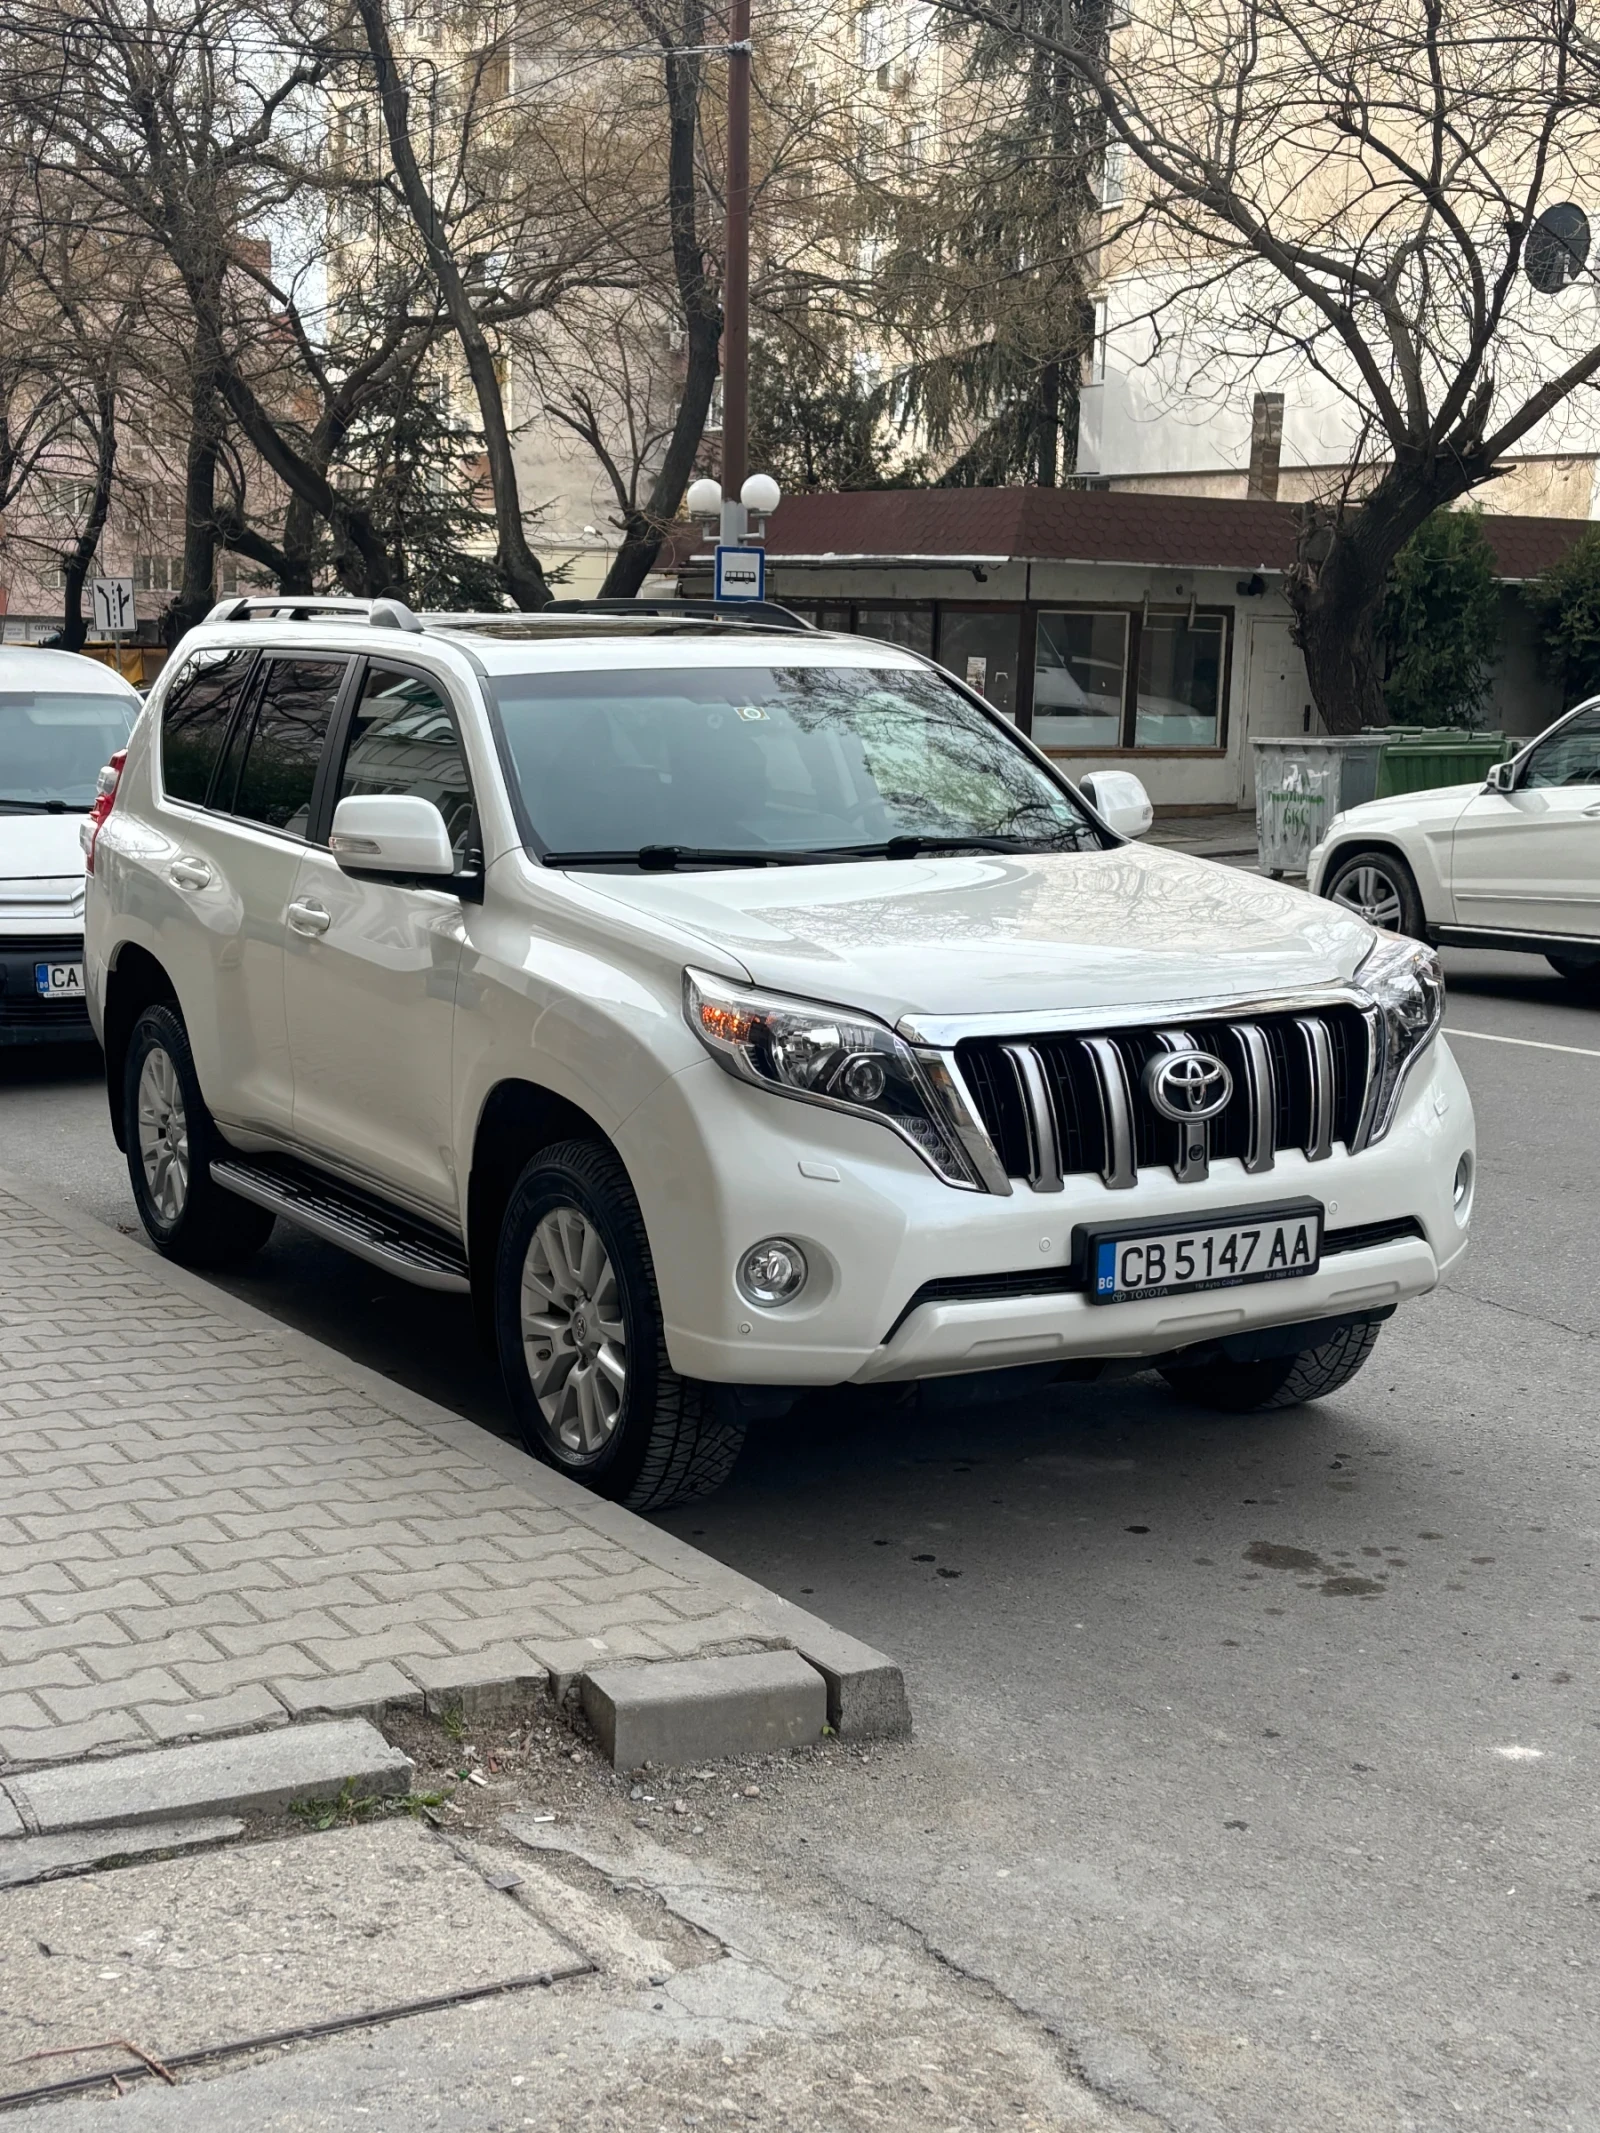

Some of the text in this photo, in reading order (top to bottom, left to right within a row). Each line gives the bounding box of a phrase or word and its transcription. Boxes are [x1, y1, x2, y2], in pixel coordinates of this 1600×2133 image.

[51, 967, 79, 988] CA
[1121, 1224, 1311, 1288] CB 5147 AA
[1098, 1276, 1114, 1290] BG
[1129, 1287, 1169, 1300] TOYOTA
